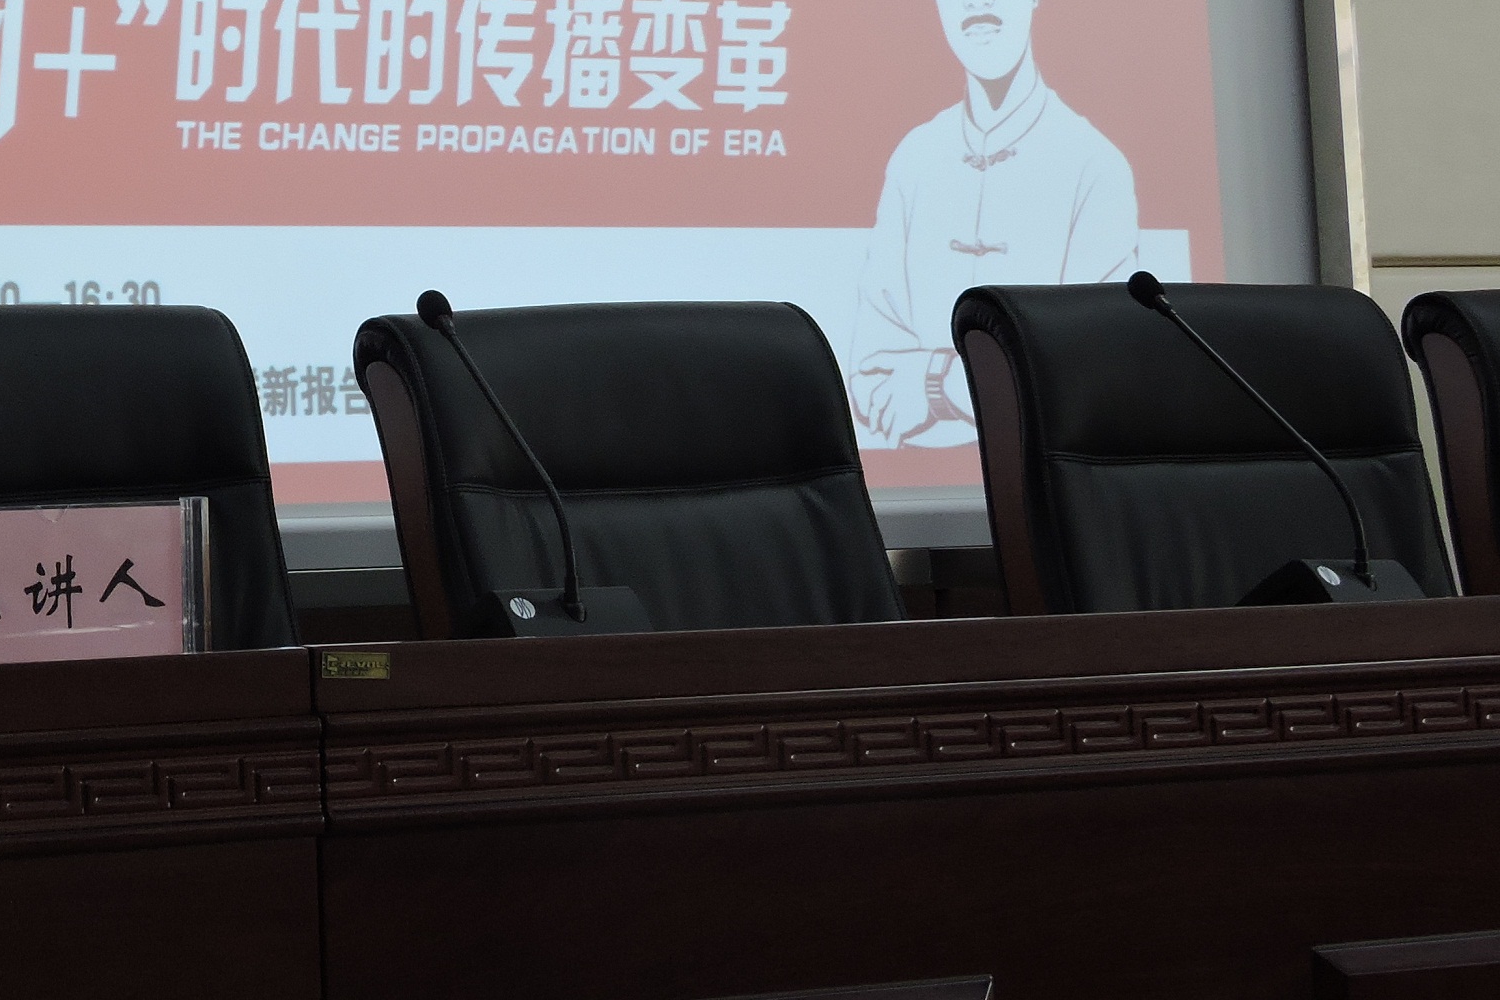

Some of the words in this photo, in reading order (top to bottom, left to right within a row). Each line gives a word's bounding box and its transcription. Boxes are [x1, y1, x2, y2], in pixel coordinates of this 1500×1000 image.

[176, 120, 243, 151] THE
[258, 121, 402, 152] CHANGE
[416, 123, 656, 155] PROPAGATION
[669, 127, 710, 155] OF
[723, 128, 787, 156] ERA
[253, 364, 371, 416] 新报告
